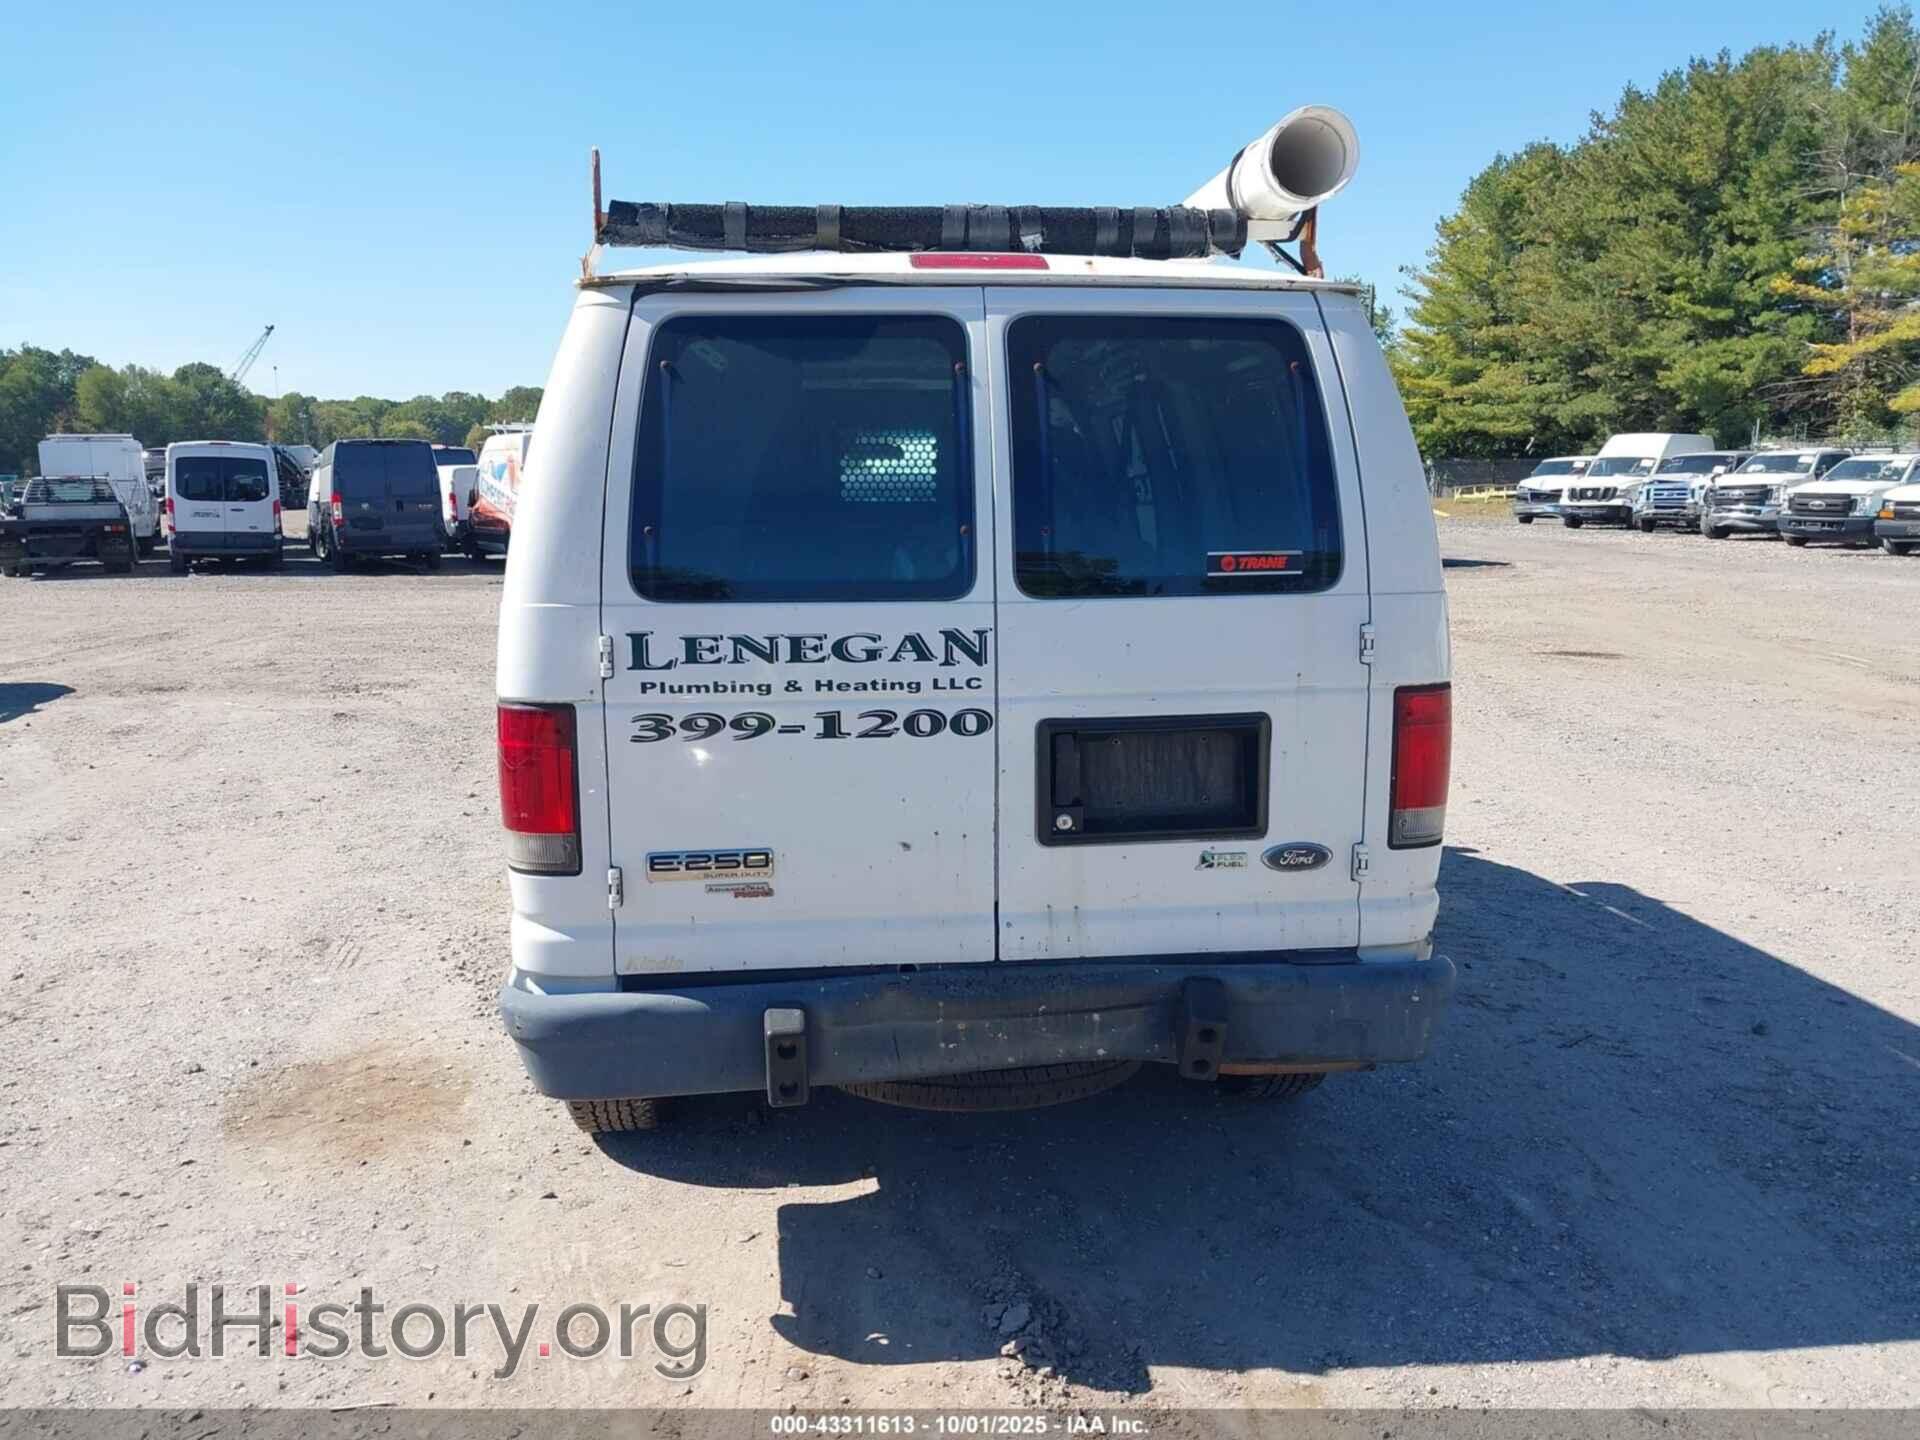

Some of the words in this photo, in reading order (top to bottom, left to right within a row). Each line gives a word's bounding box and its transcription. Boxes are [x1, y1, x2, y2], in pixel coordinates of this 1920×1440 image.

[1239, 556, 1288, 569] TRANE
[640, 681, 772, 696] Plumbing
[783, 680, 803, 693] &
[815, 678, 921, 693] Heating
[932, 677, 983, 691] LLC
[630, 708, 993, 743] 399-1200
[650, 852, 769, 872] E-250
